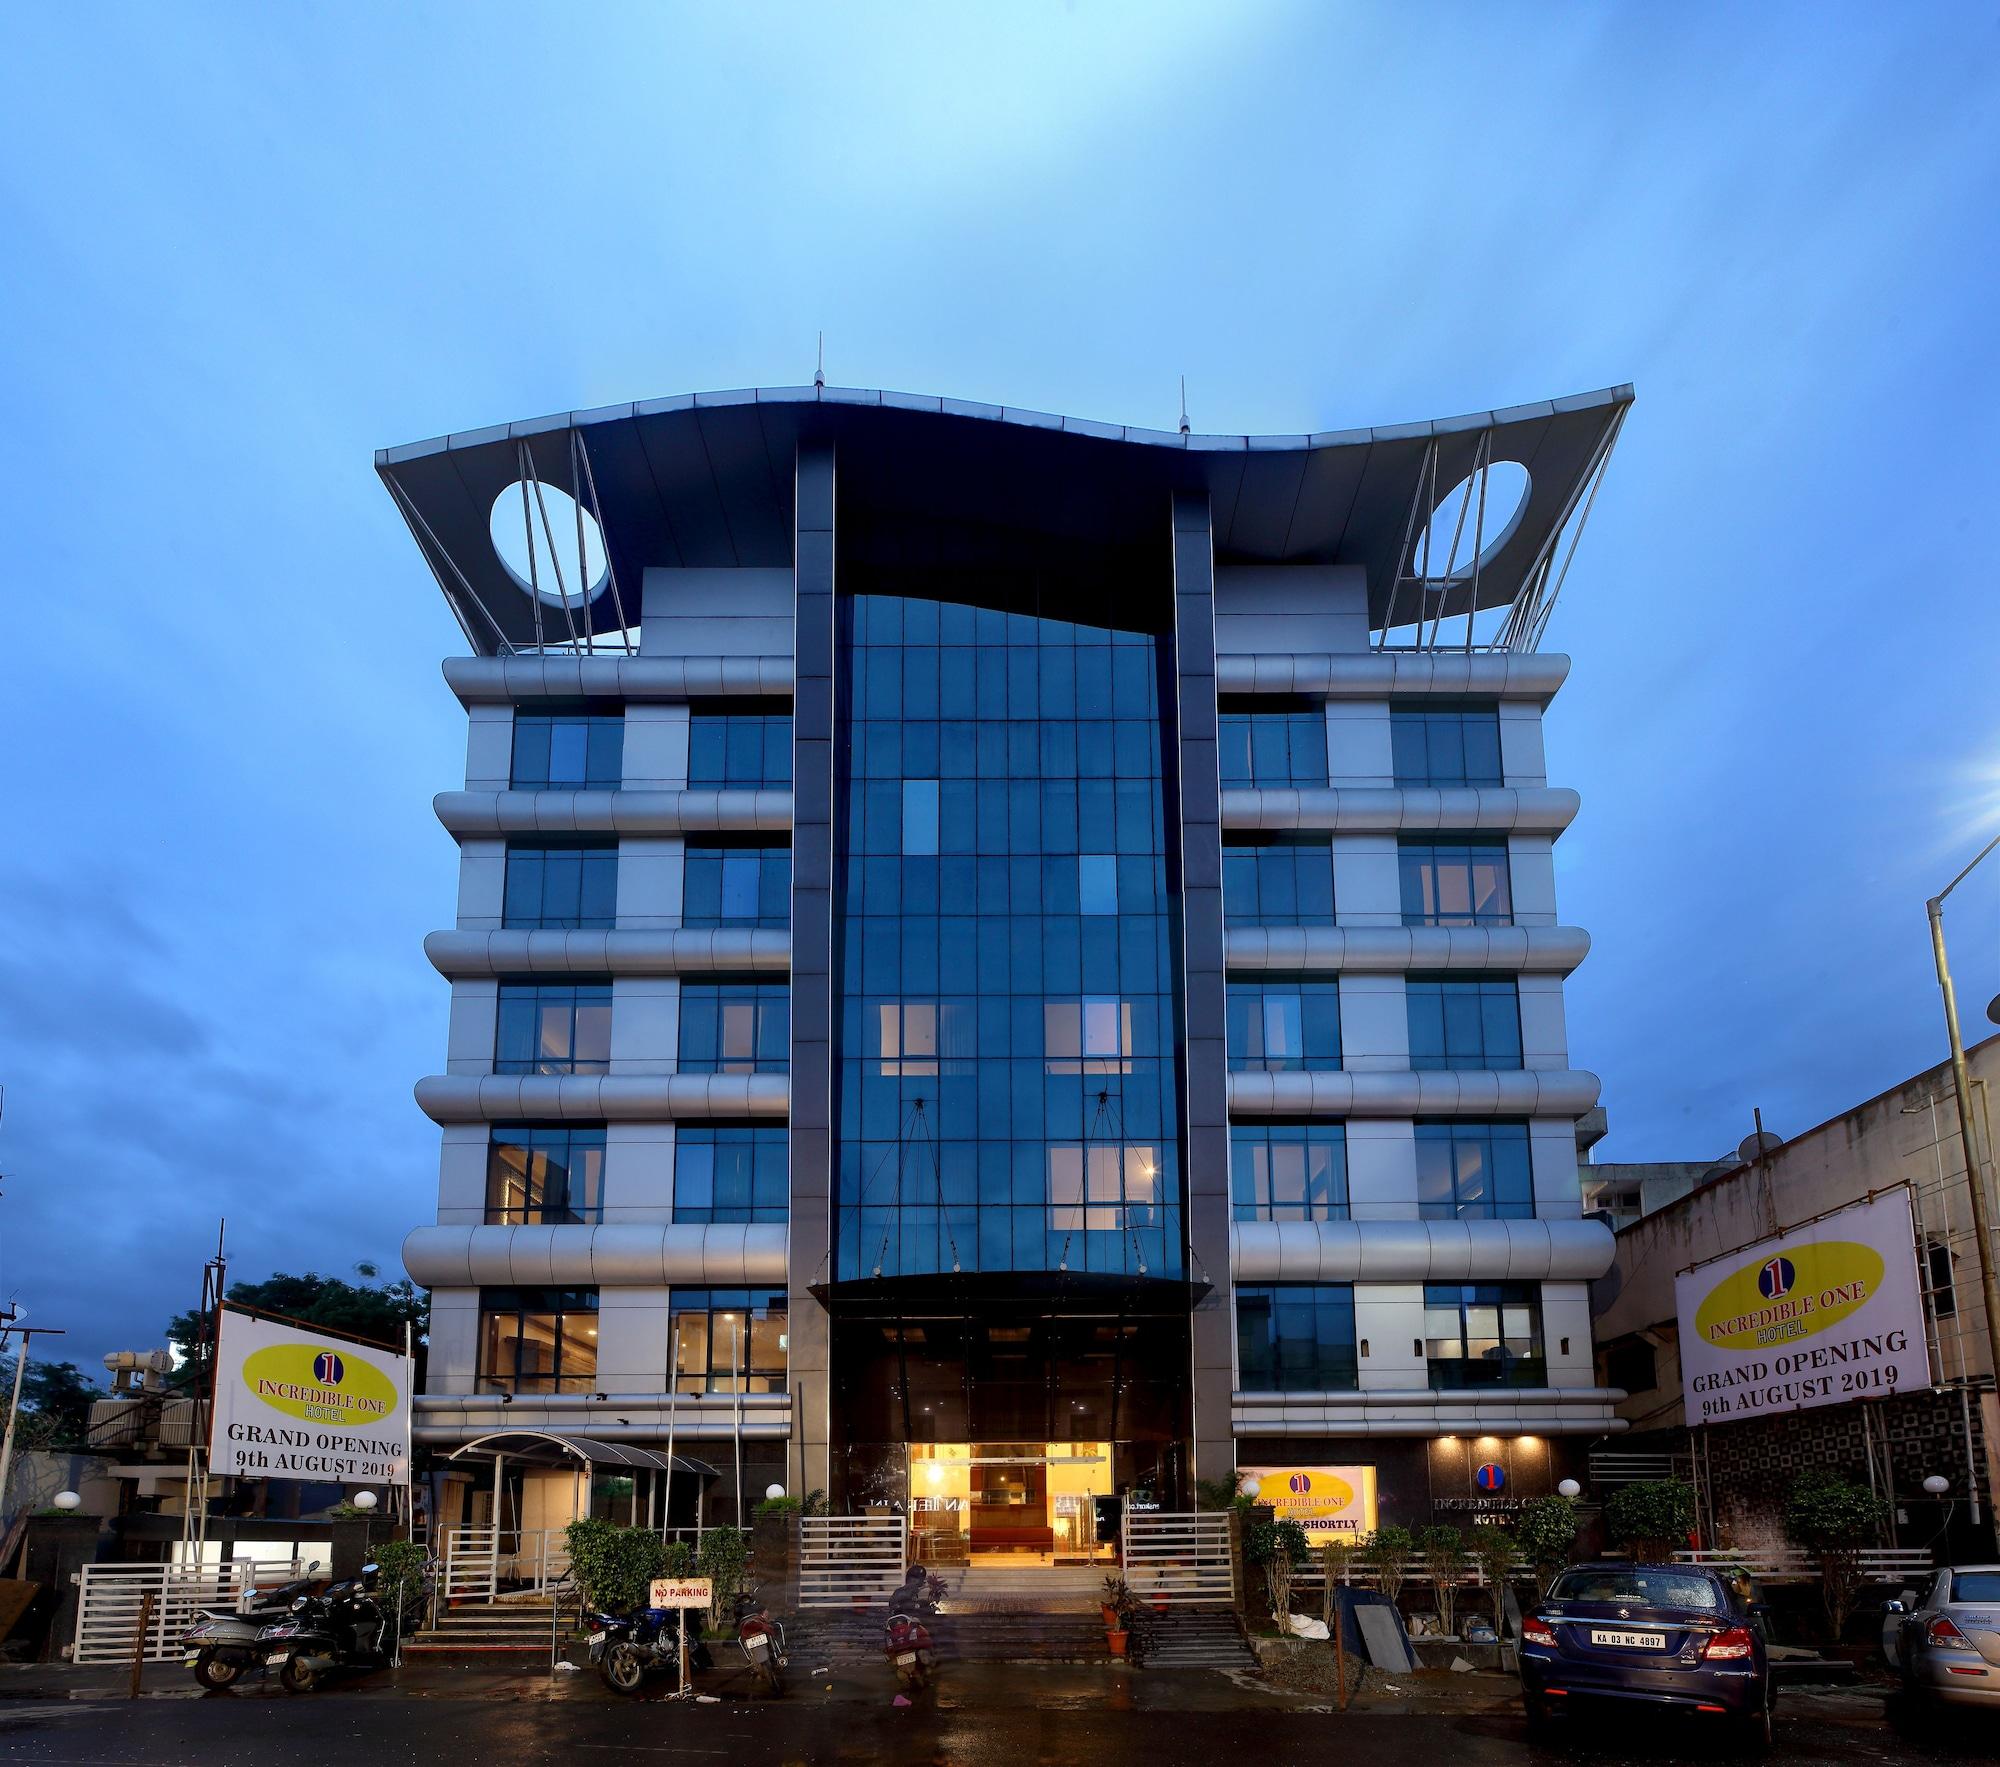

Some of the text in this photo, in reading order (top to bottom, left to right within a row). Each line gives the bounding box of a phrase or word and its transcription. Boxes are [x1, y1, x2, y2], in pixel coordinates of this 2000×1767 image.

[1765, 1258, 1789, 1300] 1
[1709, 1280, 1866, 1340] INCREDIBLE ONE
[1757, 1320, 1808, 1345] HOTEL
[321, 1353, 337, 1386] 1
[1692, 1330, 1908, 1393] GRAND OPENING
[258, 1379, 386, 1414] INCREDIBLE ONE
[1702, 1365, 1898, 1416] 9th AUGUST 2019
[305, 1404, 346, 1422] HOTEL
[227, 1423, 402, 1457] GRAND OPENING
[236, 1450, 395, 1477] 9th AUGUST 2019
[1323, 1497, 1345, 1507] ONE
[1302, 1519, 1358, 1530] SHORTLY
[655, 1588, 708, 1597] NO PARKING
[1597, 1634, 1660, 1647] KA 03 NC 4897
